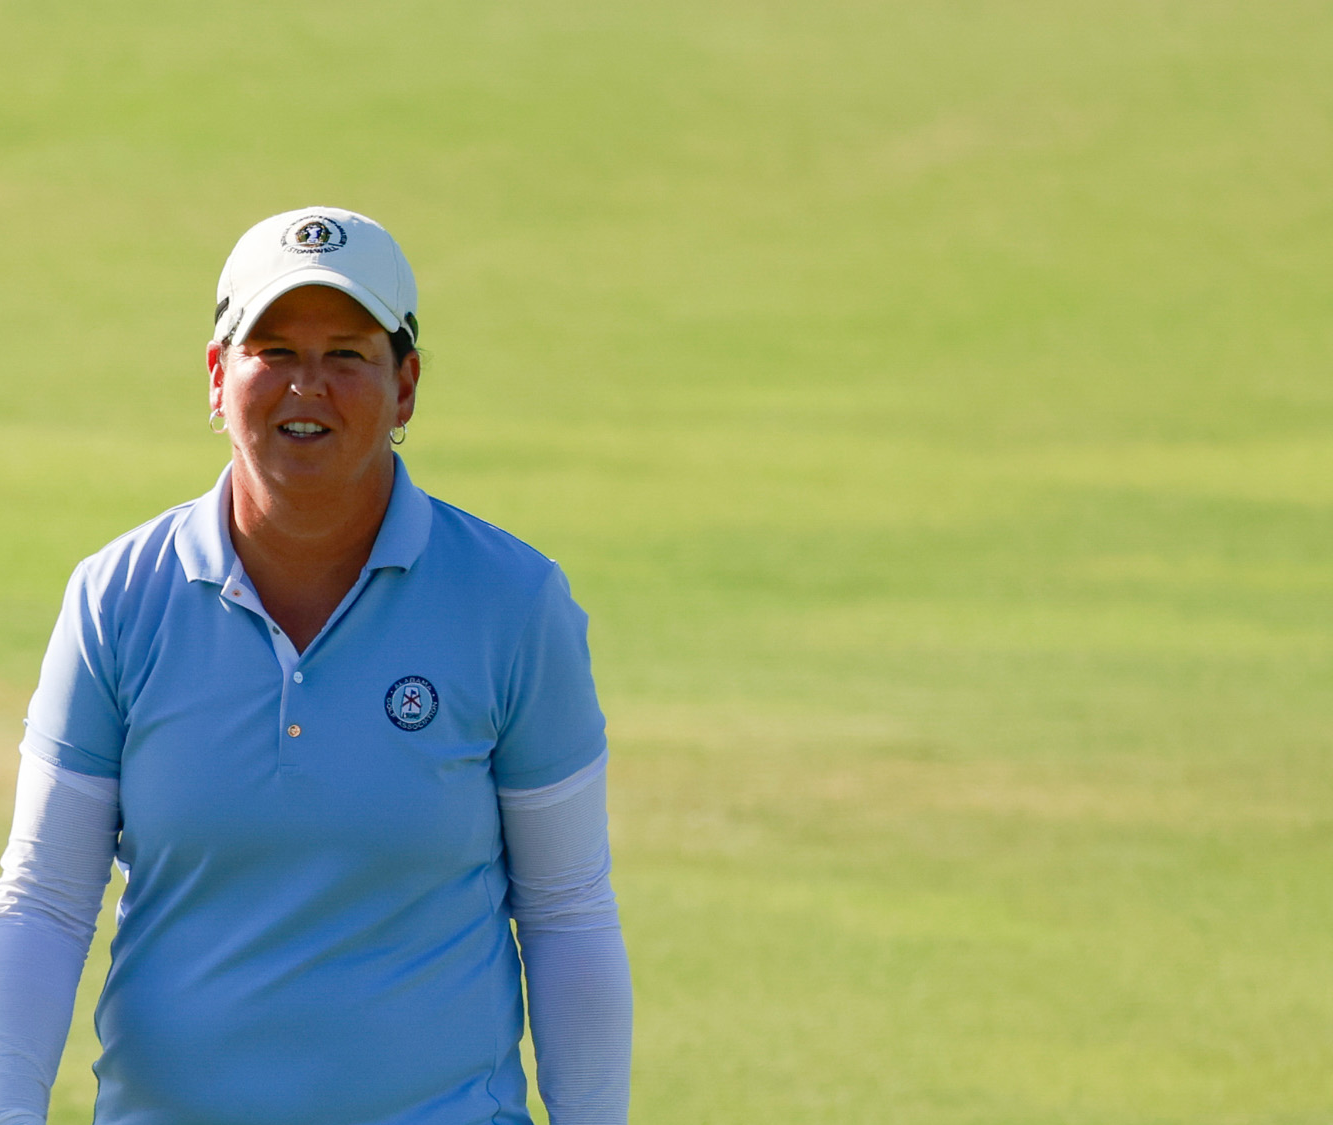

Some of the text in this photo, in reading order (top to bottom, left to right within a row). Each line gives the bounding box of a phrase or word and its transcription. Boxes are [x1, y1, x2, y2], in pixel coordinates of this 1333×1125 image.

[394, 677, 431, 690] ALABAMA
[386, 697, 438, 729] GOLF ASSOCIATION
